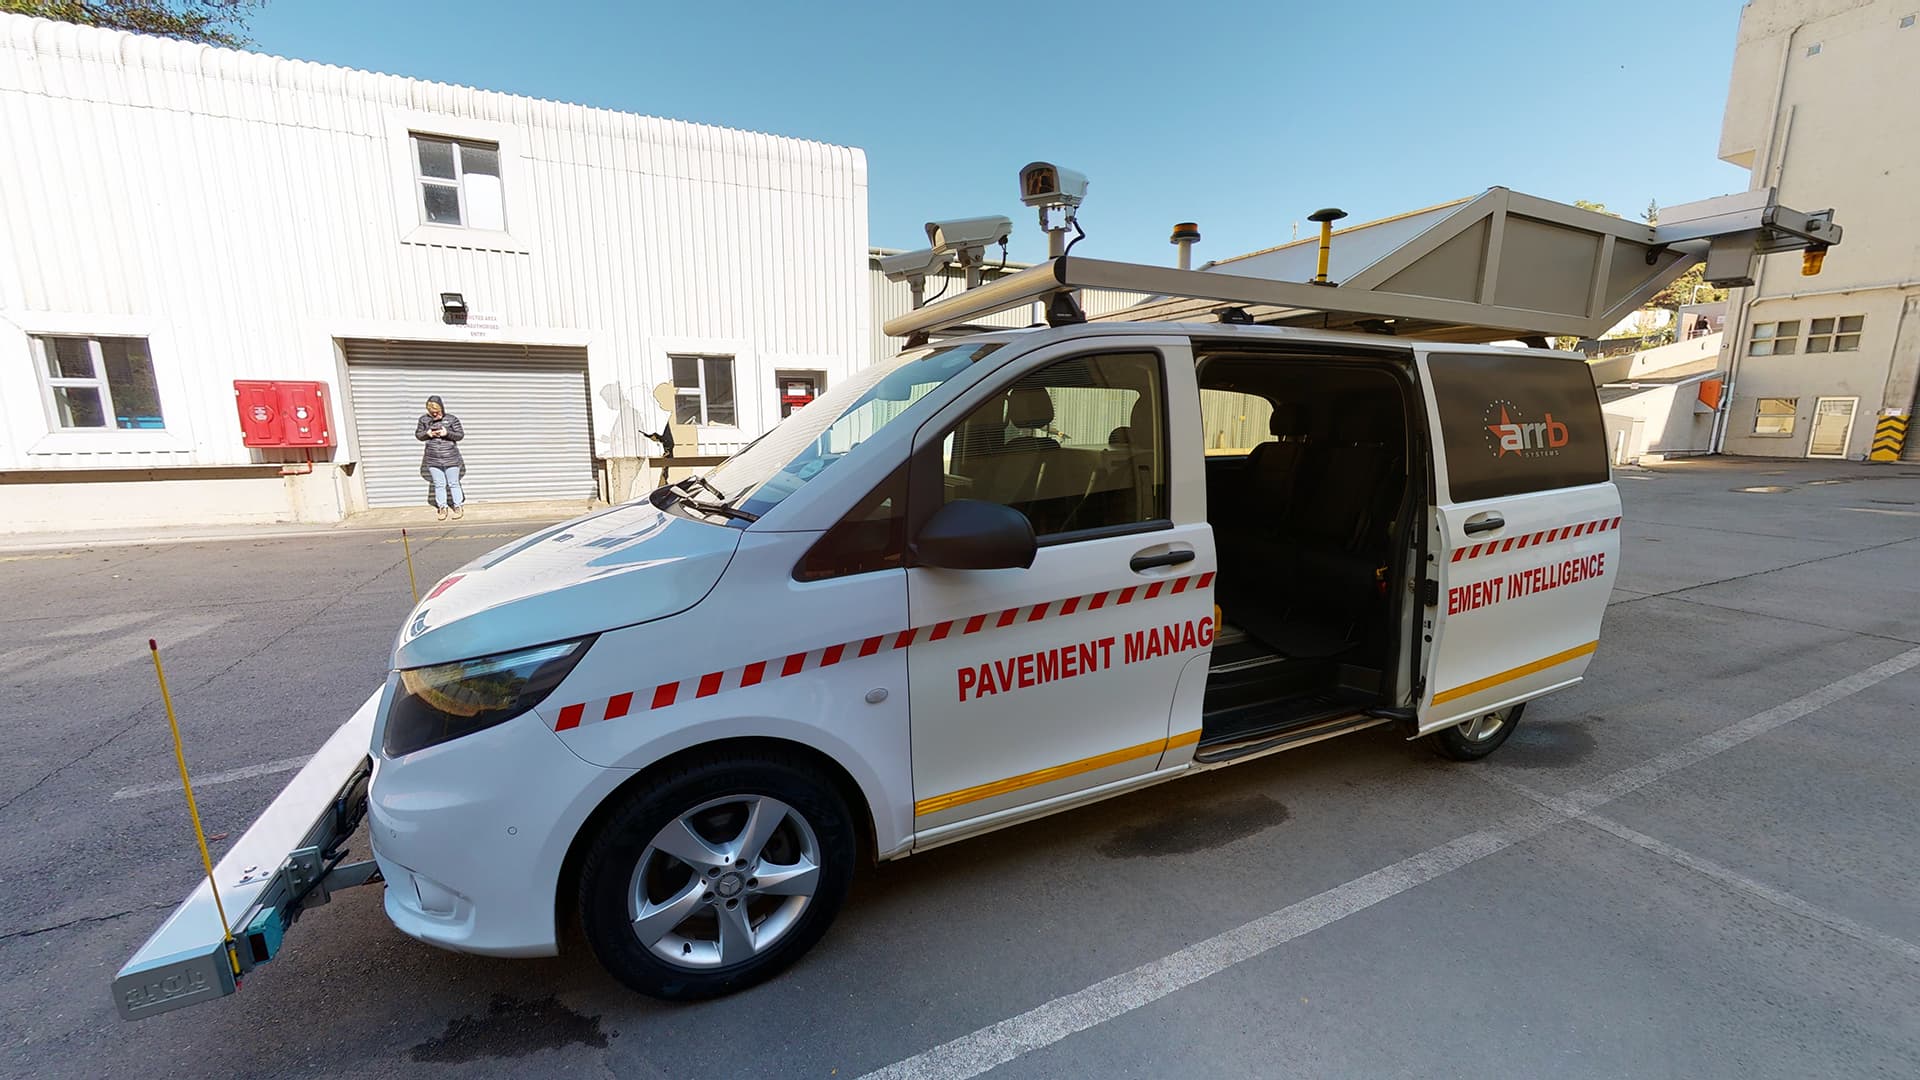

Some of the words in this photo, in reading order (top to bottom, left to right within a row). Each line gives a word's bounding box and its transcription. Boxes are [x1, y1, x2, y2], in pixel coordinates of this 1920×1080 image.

[1500, 412, 1569, 451] arrb
[1525, 450, 1560, 458] SYSTEMS
[1448, 577, 1503, 615] EMENT
[1507, 553, 1605, 600] INTELLIGENCE
[957, 637, 1115, 702] PAVEMENT
[1124, 616, 1214, 664] MANAG
